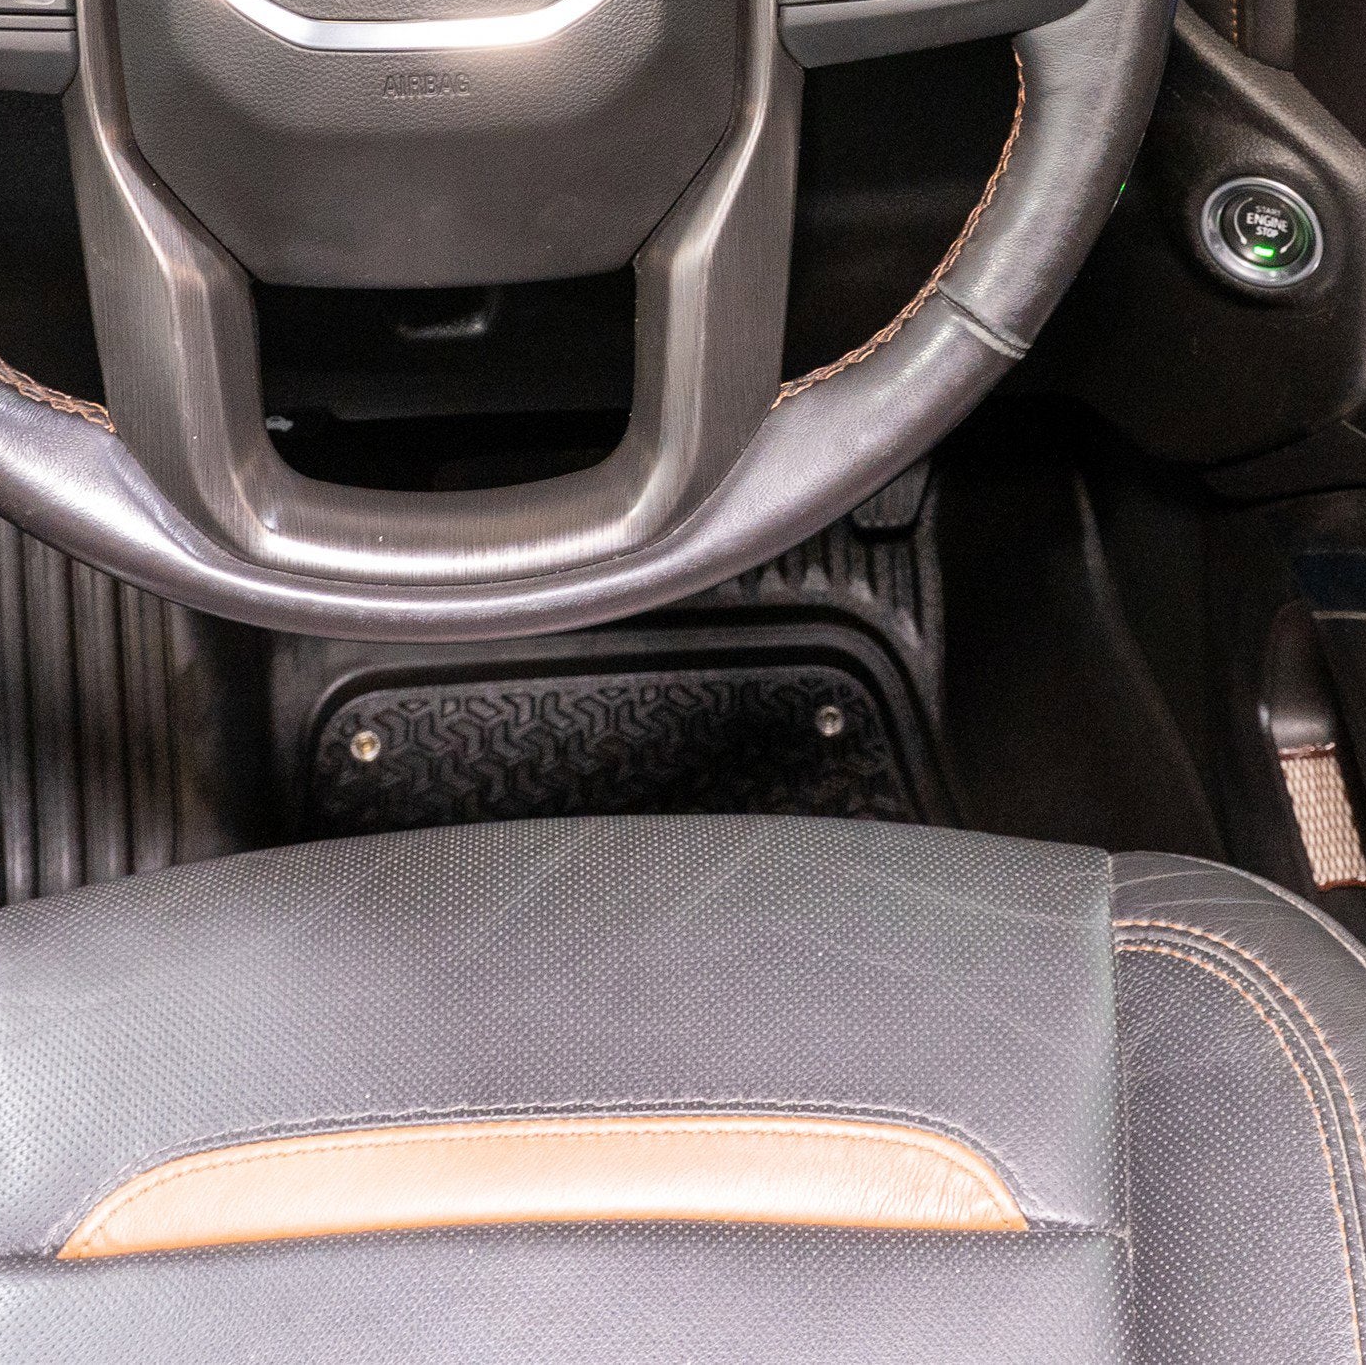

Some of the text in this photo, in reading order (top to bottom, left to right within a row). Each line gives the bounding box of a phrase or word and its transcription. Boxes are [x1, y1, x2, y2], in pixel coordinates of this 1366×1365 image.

[382, 75, 471, 97] AIRBAG
[1246, 212, 1289, 234] ENGINE
[1255, 226, 1279, 238] STOP
